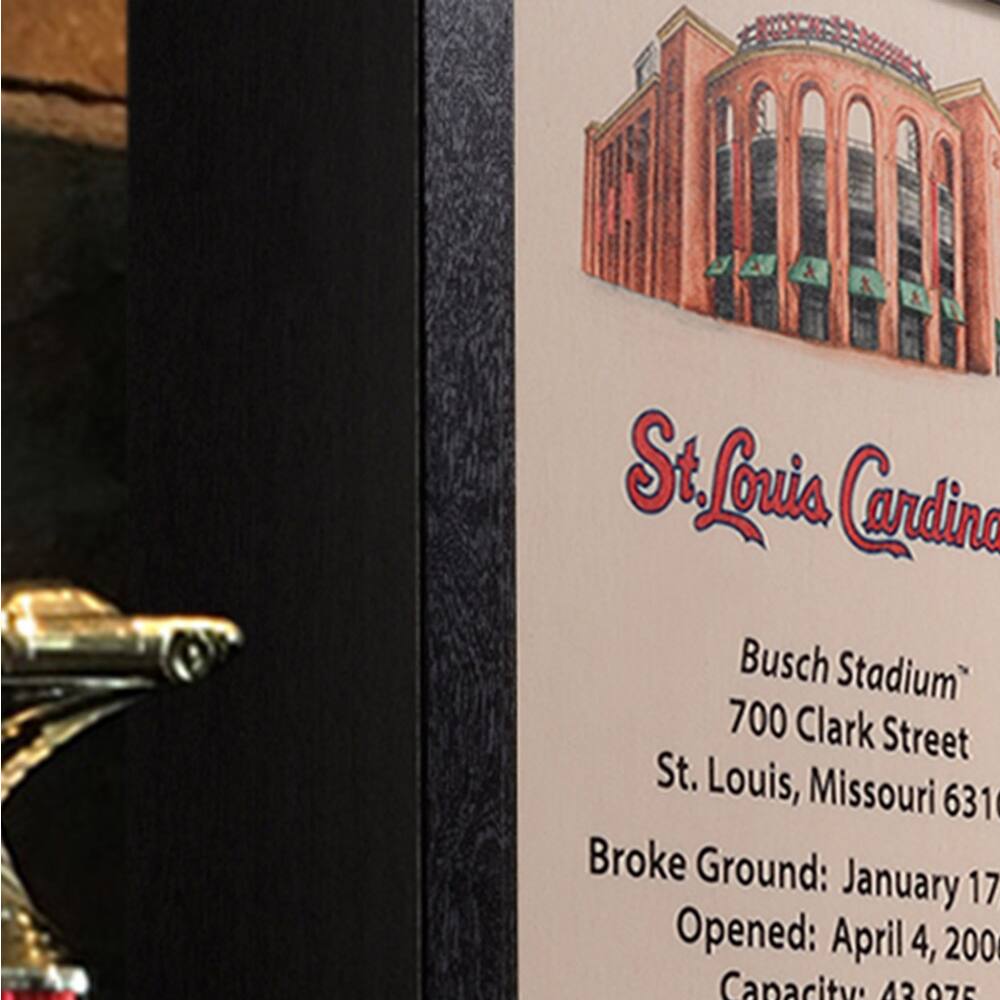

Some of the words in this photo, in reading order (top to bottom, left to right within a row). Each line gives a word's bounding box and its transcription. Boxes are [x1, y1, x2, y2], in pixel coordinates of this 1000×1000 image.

[626, 409, 707, 514] St.
[693, 426, 832, 549] Louis
[740, 637, 829, 684] Busch
[837, 650, 958, 700] Stadium
[729, 697, 788, 739] 700
[796, 705, 875, 750] Clark
[883, 715, 969, 760] Street
[657, 750, 698, 792] St.
[708, 755, 800, 806] Louis,
[809, 766, 935, 815] Missouri
[589, 836, 687, 882] Broke
[696, 845, 827, 892] Ground:
[842, 857, 960, 912] January
[676, 905, 816, 955] Opened:
[831, 916, 903, 964] April
[911, 923, 937, 964] 4,
